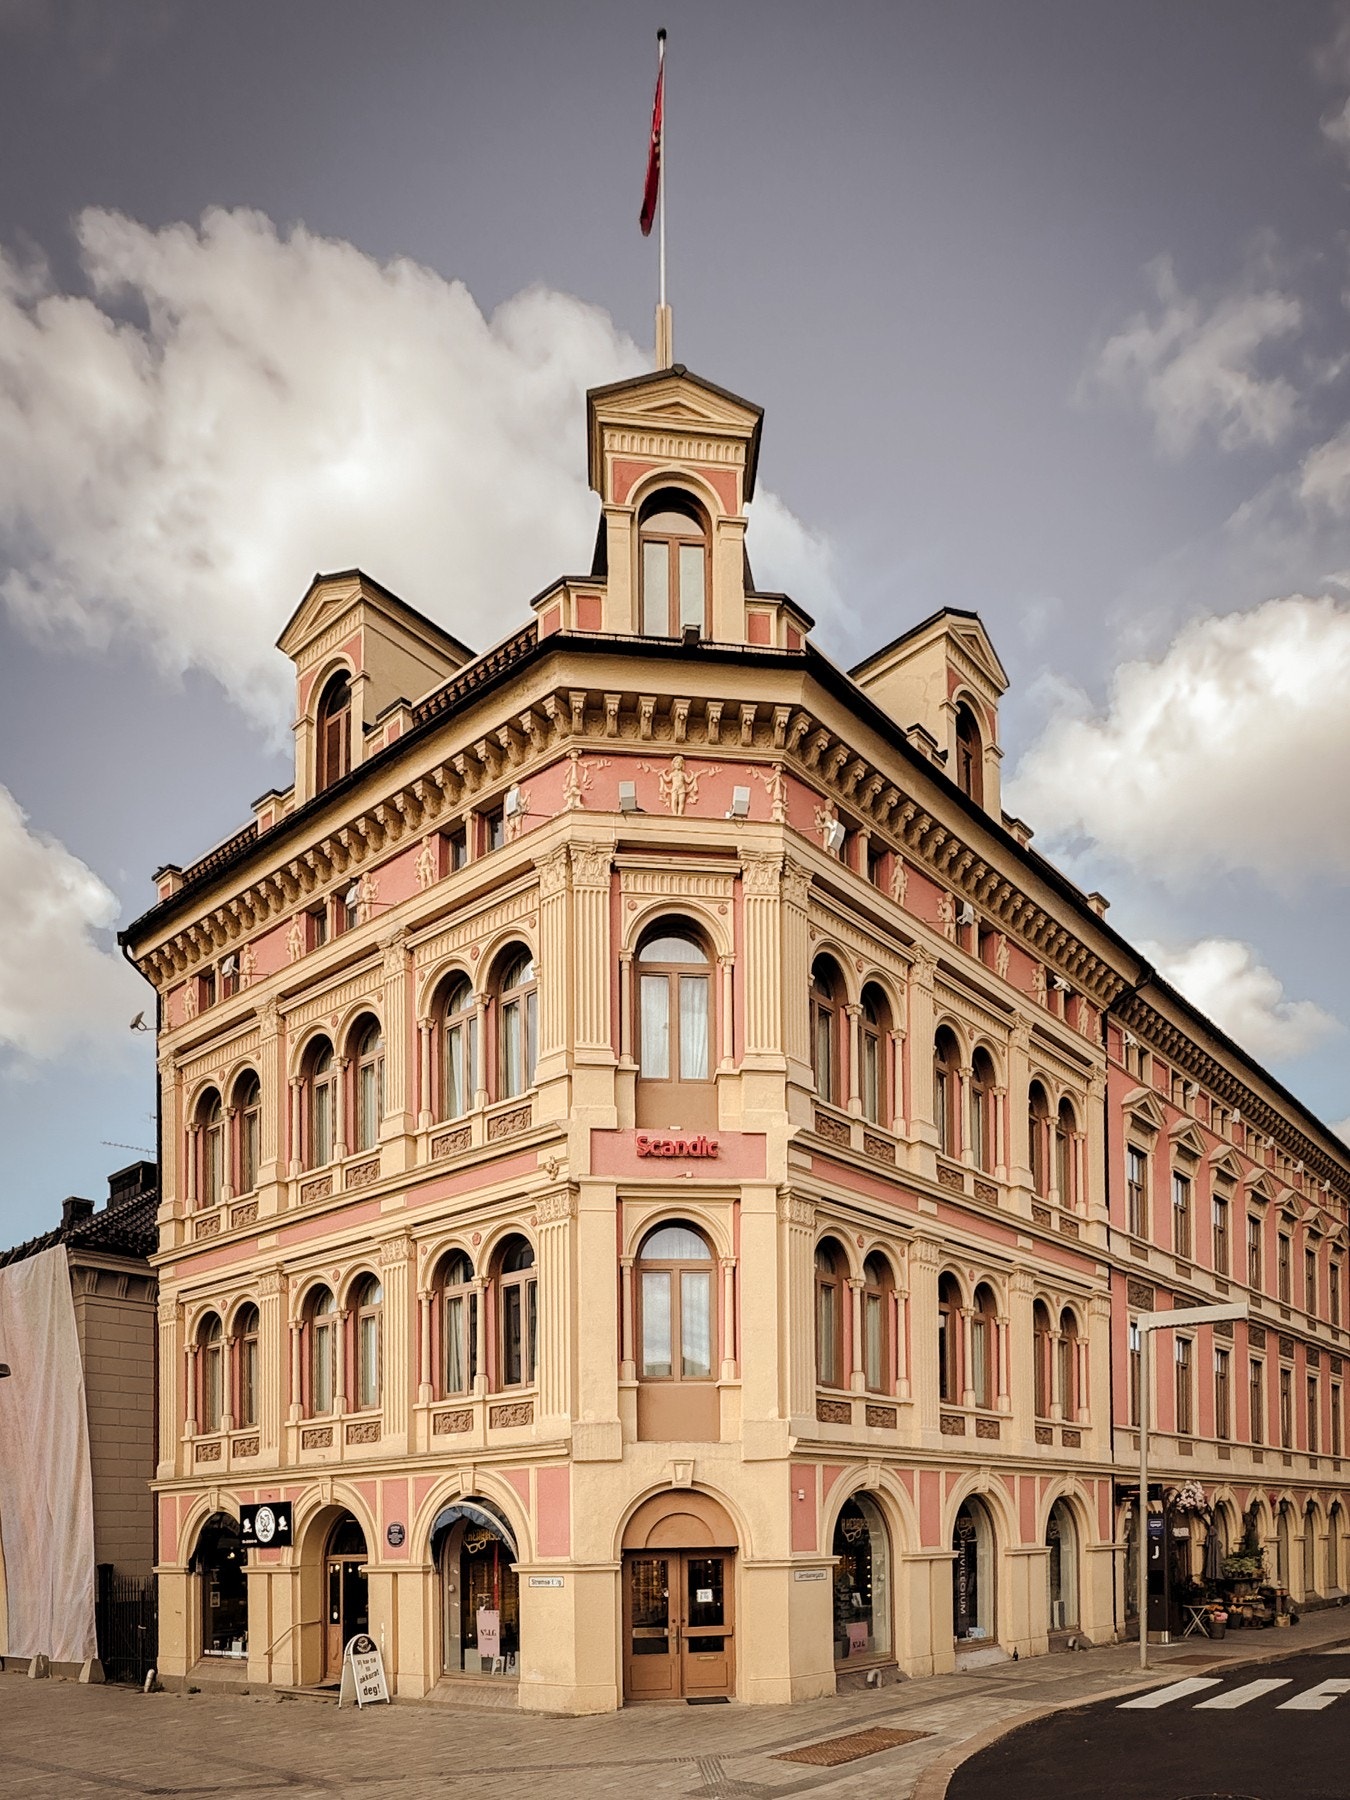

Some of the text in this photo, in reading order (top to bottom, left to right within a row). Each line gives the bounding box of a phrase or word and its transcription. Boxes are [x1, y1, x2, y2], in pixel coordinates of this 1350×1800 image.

[637, 1136, 718, 1158] Scandic
[359, 1668, 380, 1684] akkurat
[363, 1683, 381, 1696] deg!
